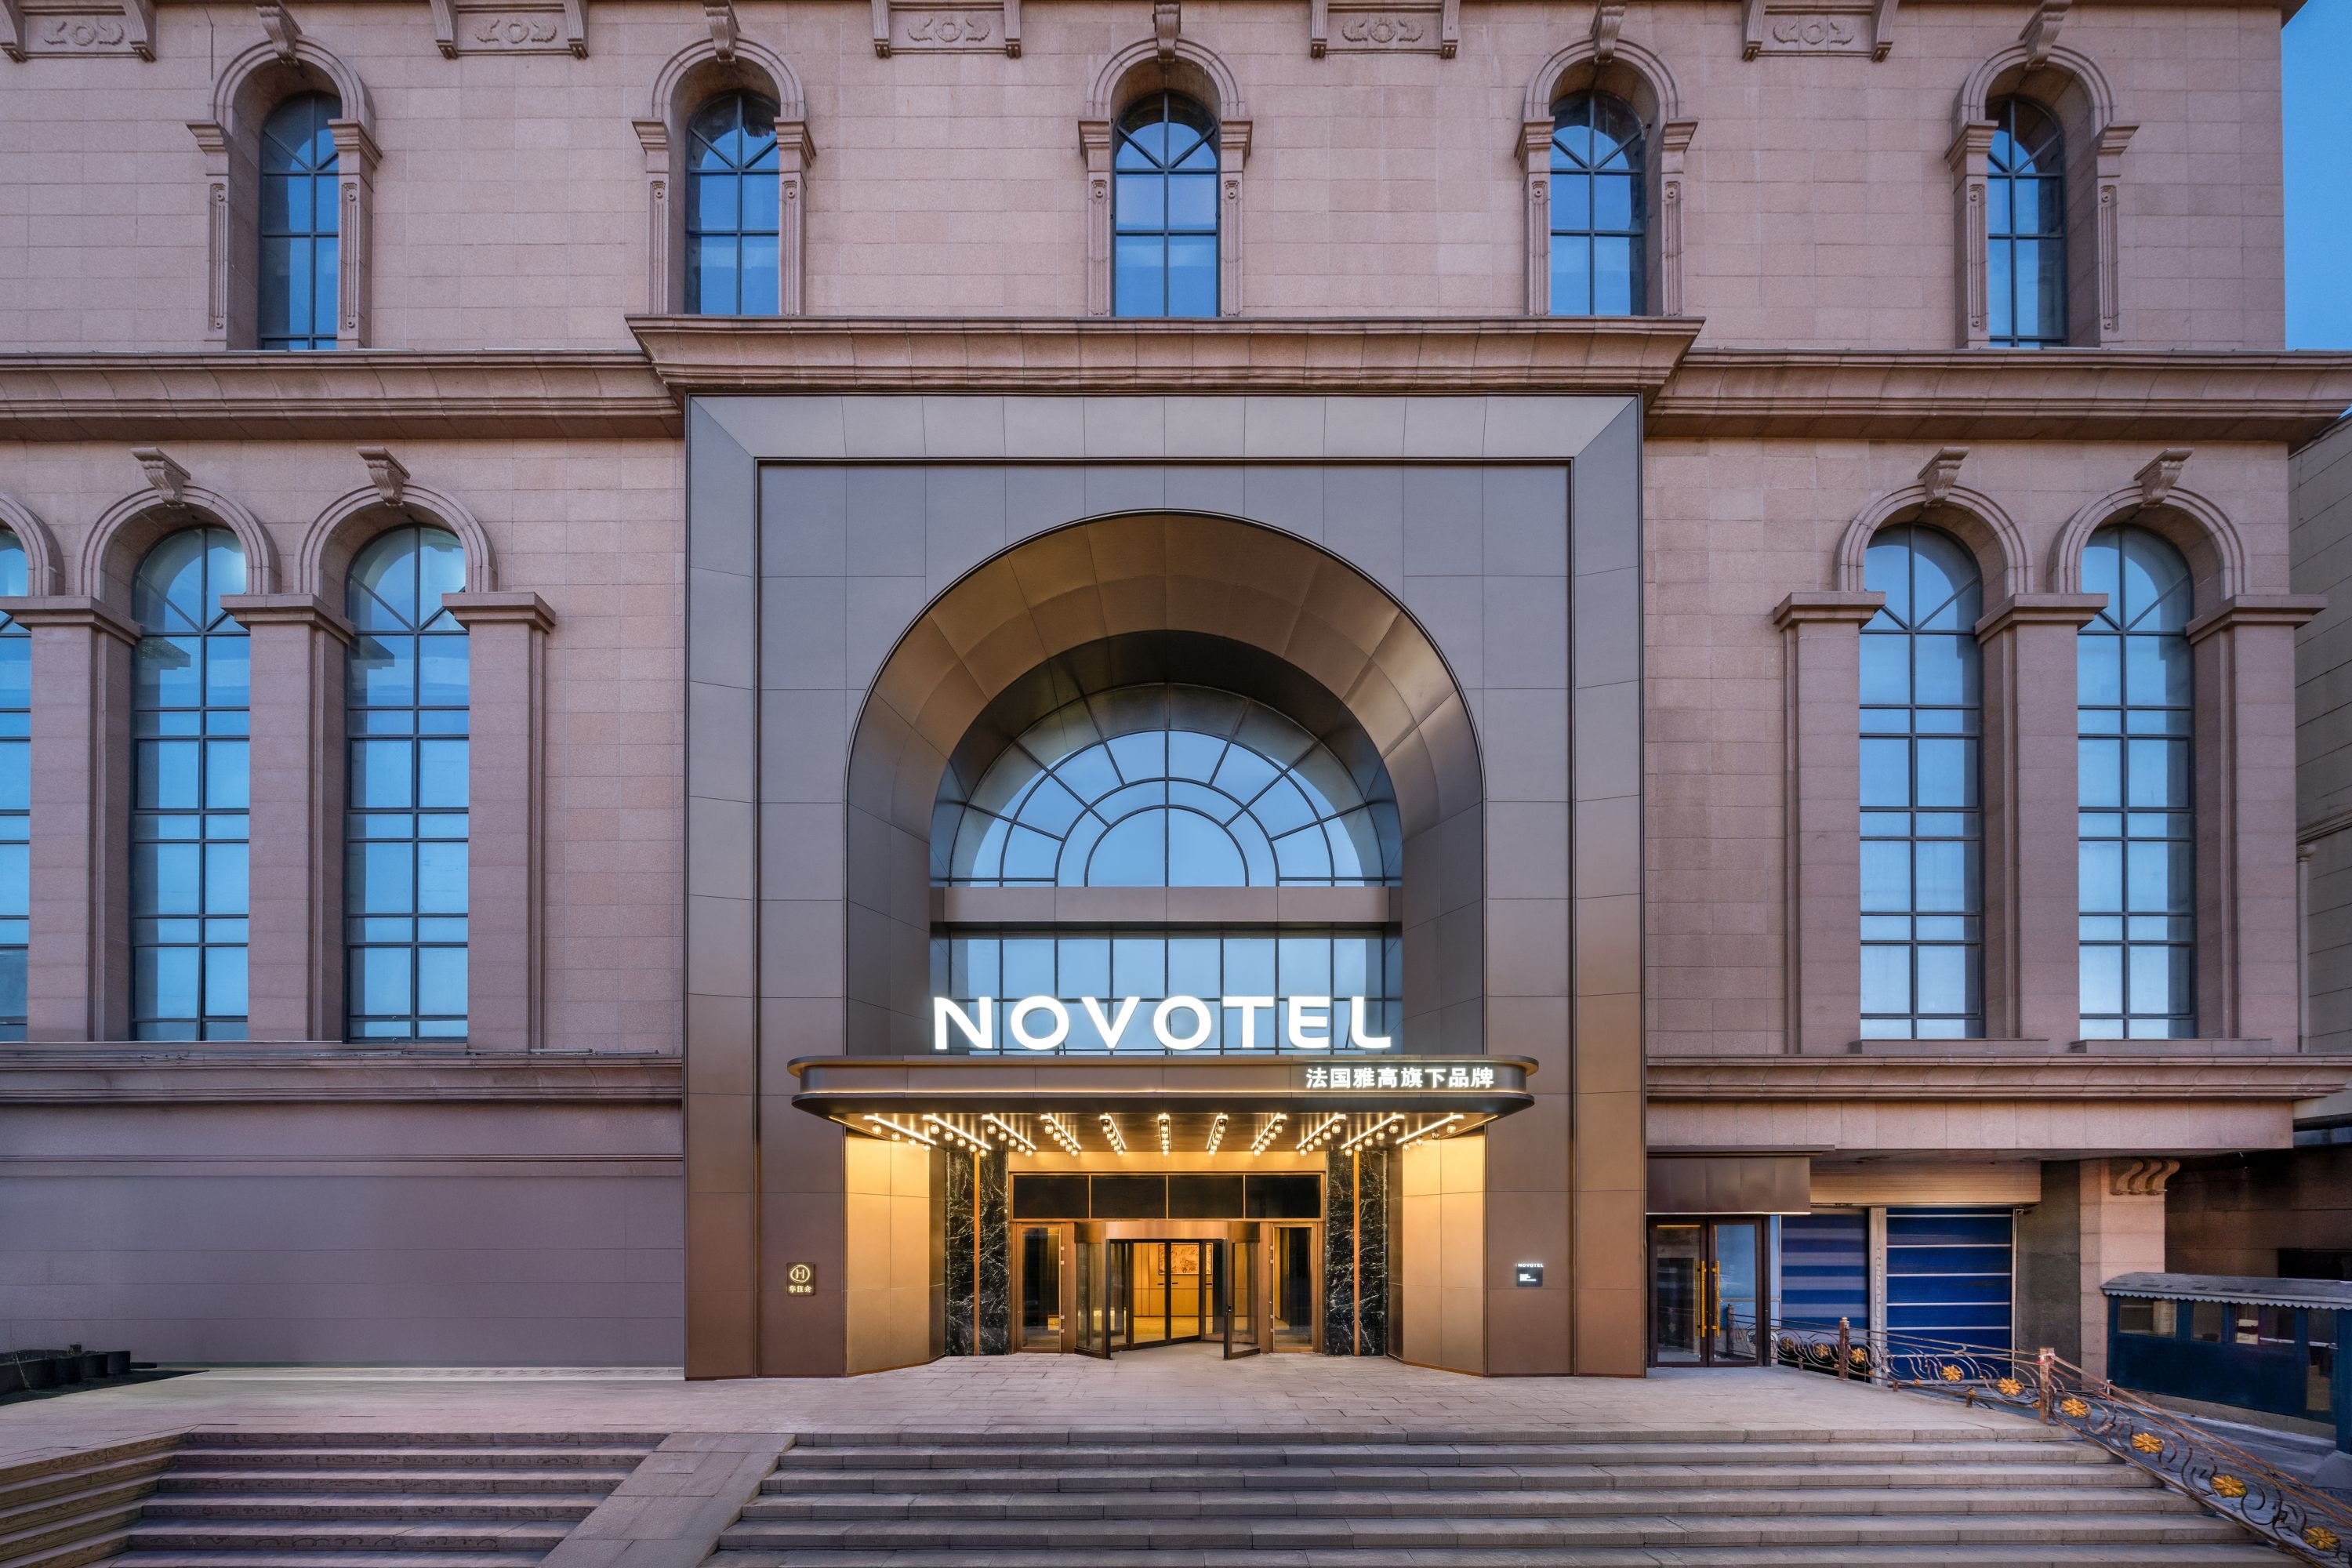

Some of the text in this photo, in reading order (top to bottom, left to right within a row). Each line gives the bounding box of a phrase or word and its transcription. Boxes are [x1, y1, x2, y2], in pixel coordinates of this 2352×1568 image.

[934, 995, 1392, 1051] NOVOTEL
[1305, 1067, 1495, 1089] 法国雅高旗下品牌
